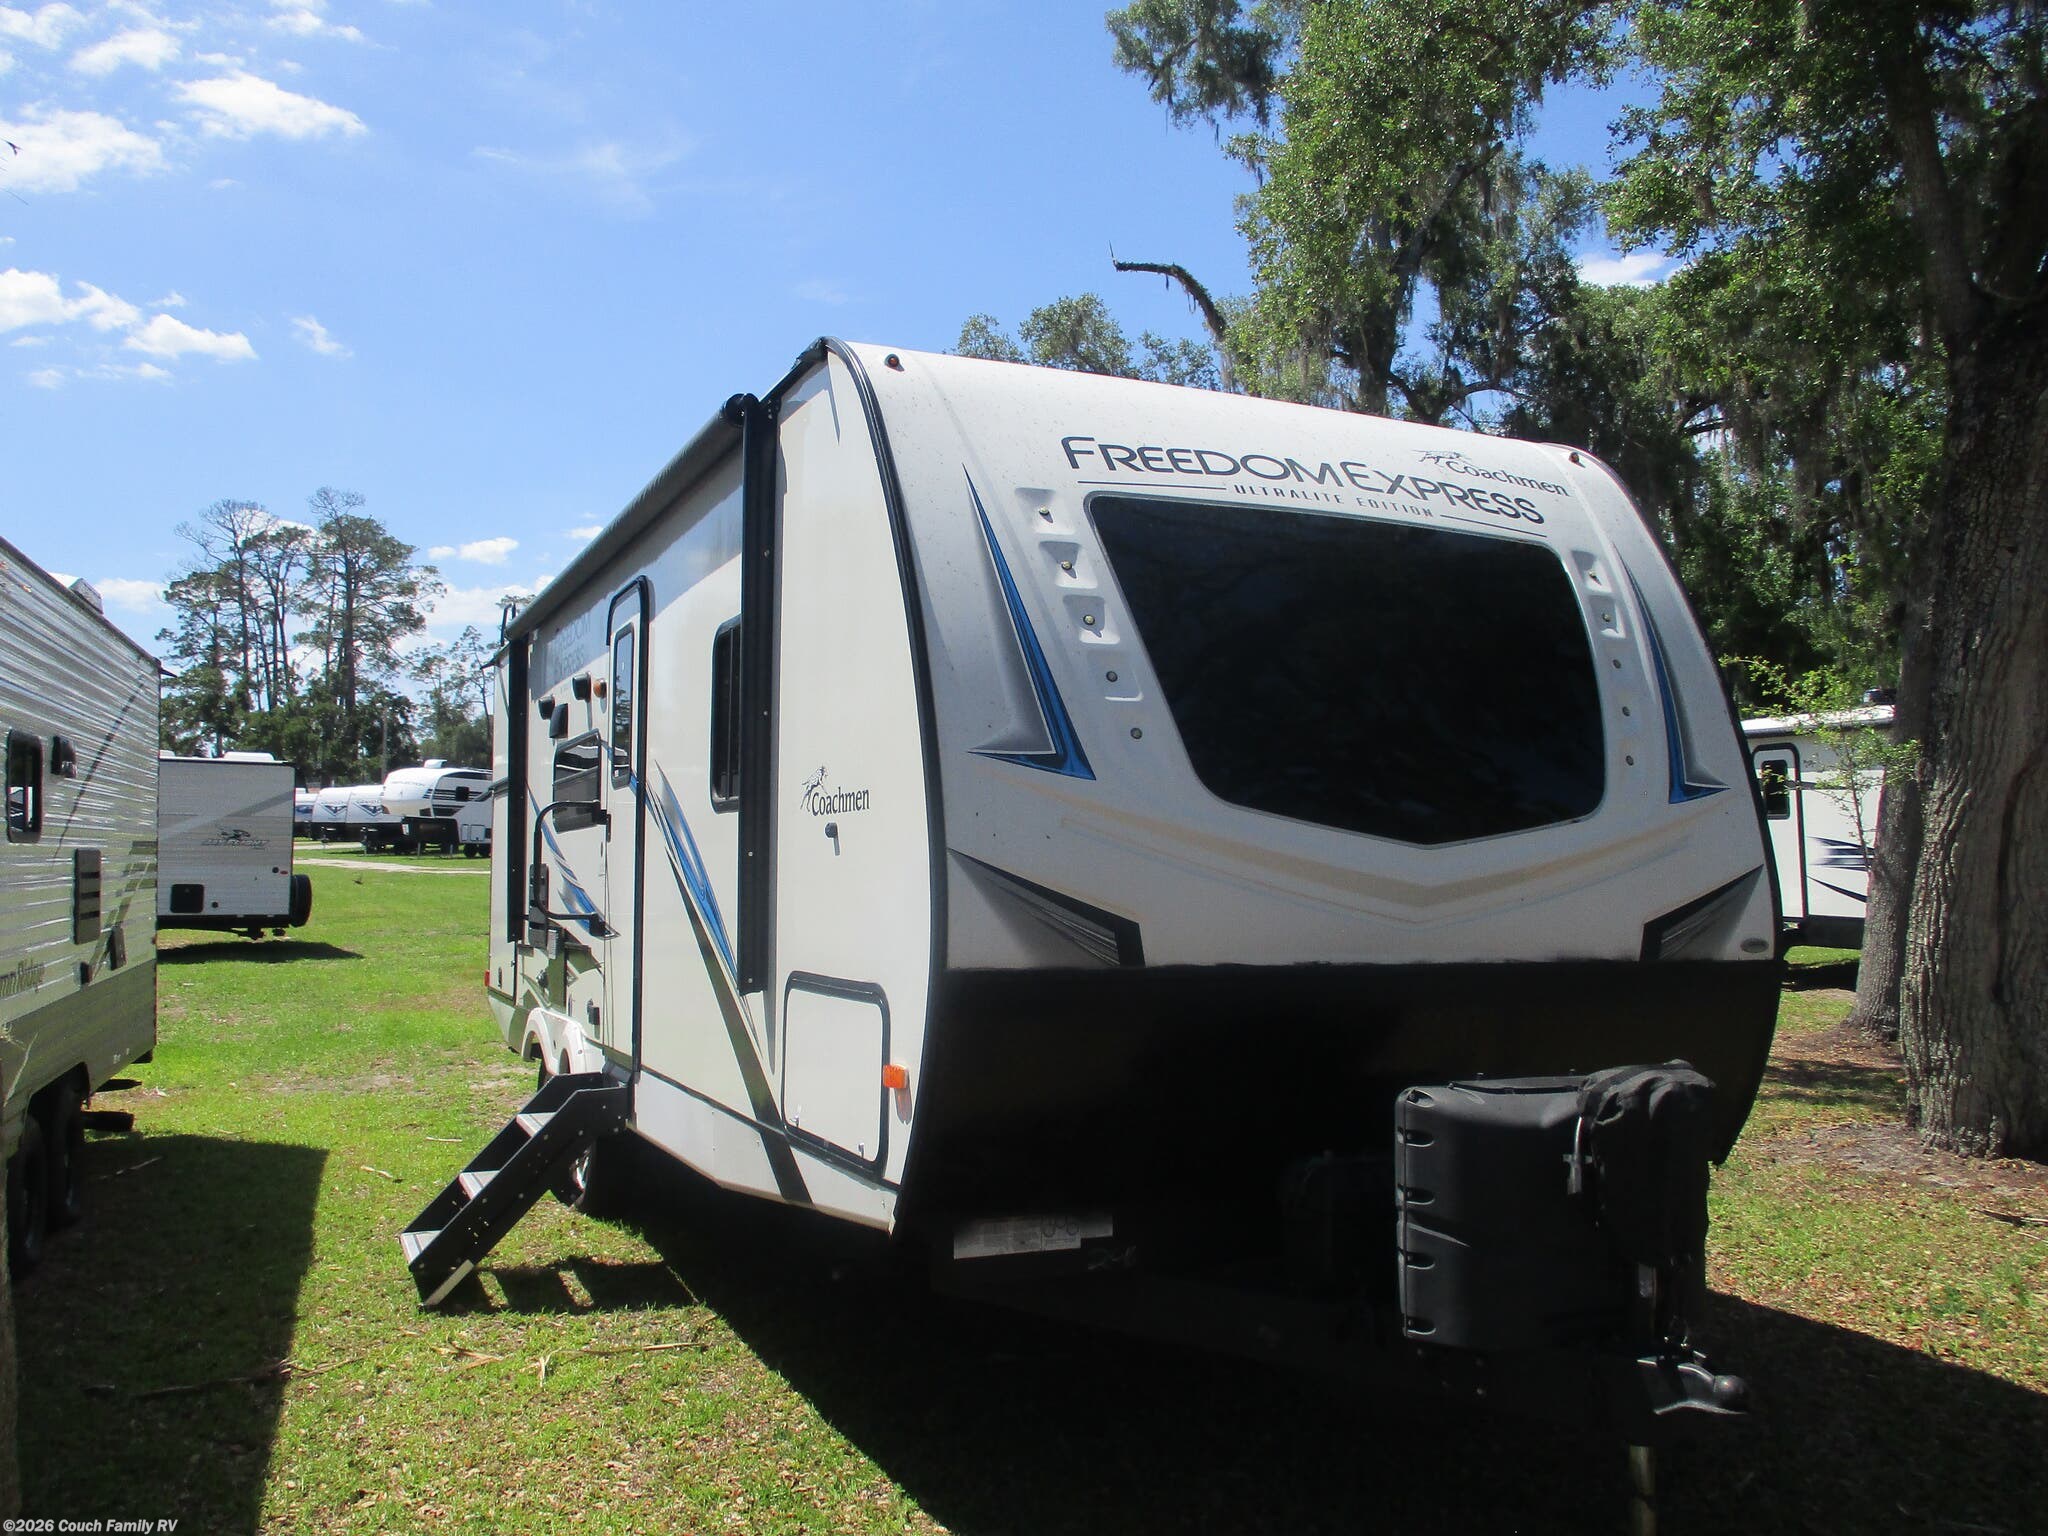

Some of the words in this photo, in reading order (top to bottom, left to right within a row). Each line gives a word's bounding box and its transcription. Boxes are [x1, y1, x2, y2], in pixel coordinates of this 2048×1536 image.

[1445, 460, 1570, 497] Coachmen
[1233, 484, 1345, 505] ULTRALITE
[1356, 496, 1434, 518] EDITION
[811, 786, 870, 816] Coachmen
